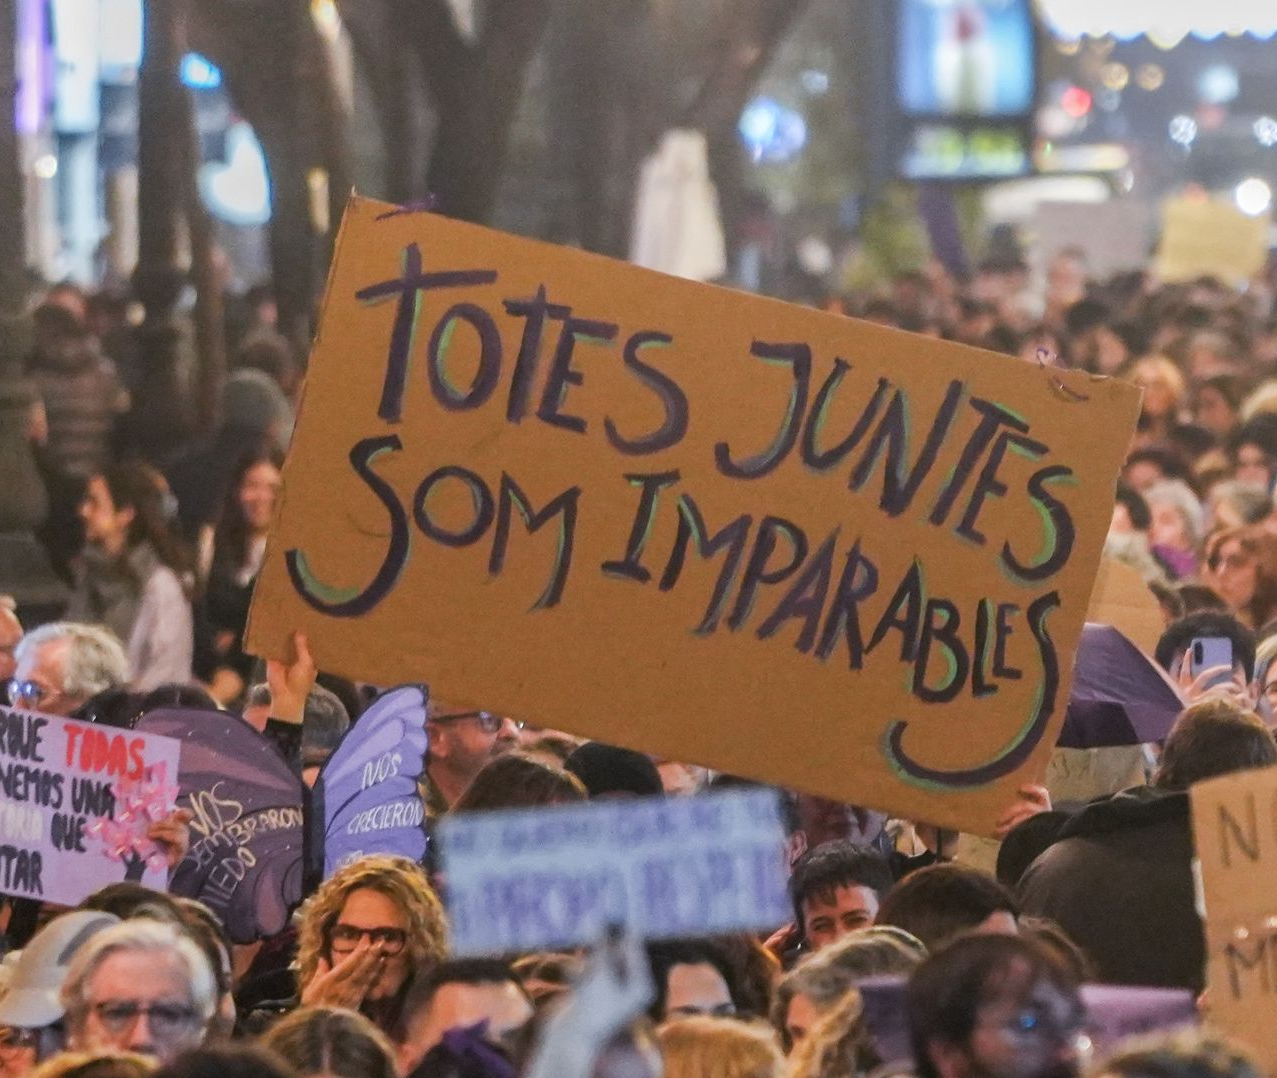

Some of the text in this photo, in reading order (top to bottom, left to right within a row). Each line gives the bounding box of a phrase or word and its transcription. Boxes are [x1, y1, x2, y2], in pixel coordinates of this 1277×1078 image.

[354, 242, 1080, 582] TOTES JUNTES
[285, 434, 1062, 790] SOM IMPARABLES
[64, 722, 146, 781] TODAS
[361, 752, 402, 790] NOS
[72, 776, 116, 820] UNA
[346, 800, 423, 835] CRECIERON
[51, 812, 88, 853] QUE
